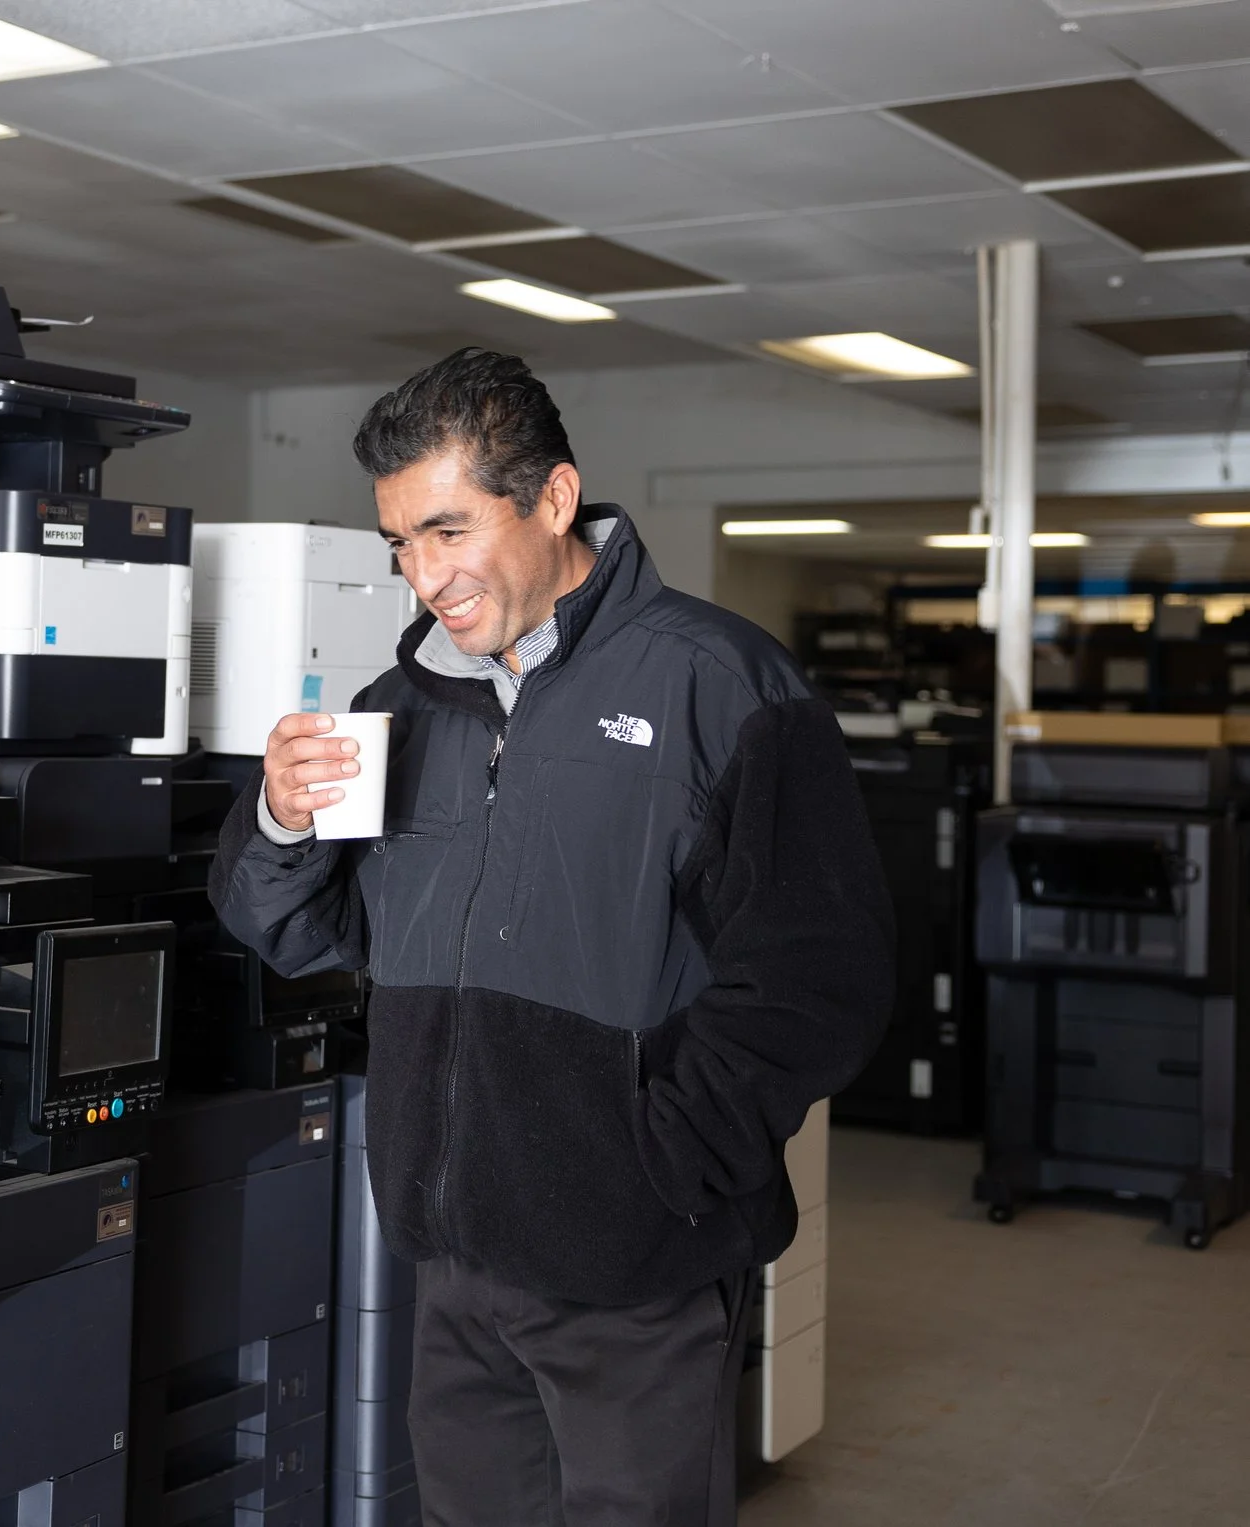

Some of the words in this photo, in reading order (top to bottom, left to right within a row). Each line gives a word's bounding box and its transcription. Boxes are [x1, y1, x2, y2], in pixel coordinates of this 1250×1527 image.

[45, 530, 82, 541] MFP61307
[598, 718, 634, 734] NORTH
[617, 713, 639, 726] THE
[604, 729, 633, 743] FACE
